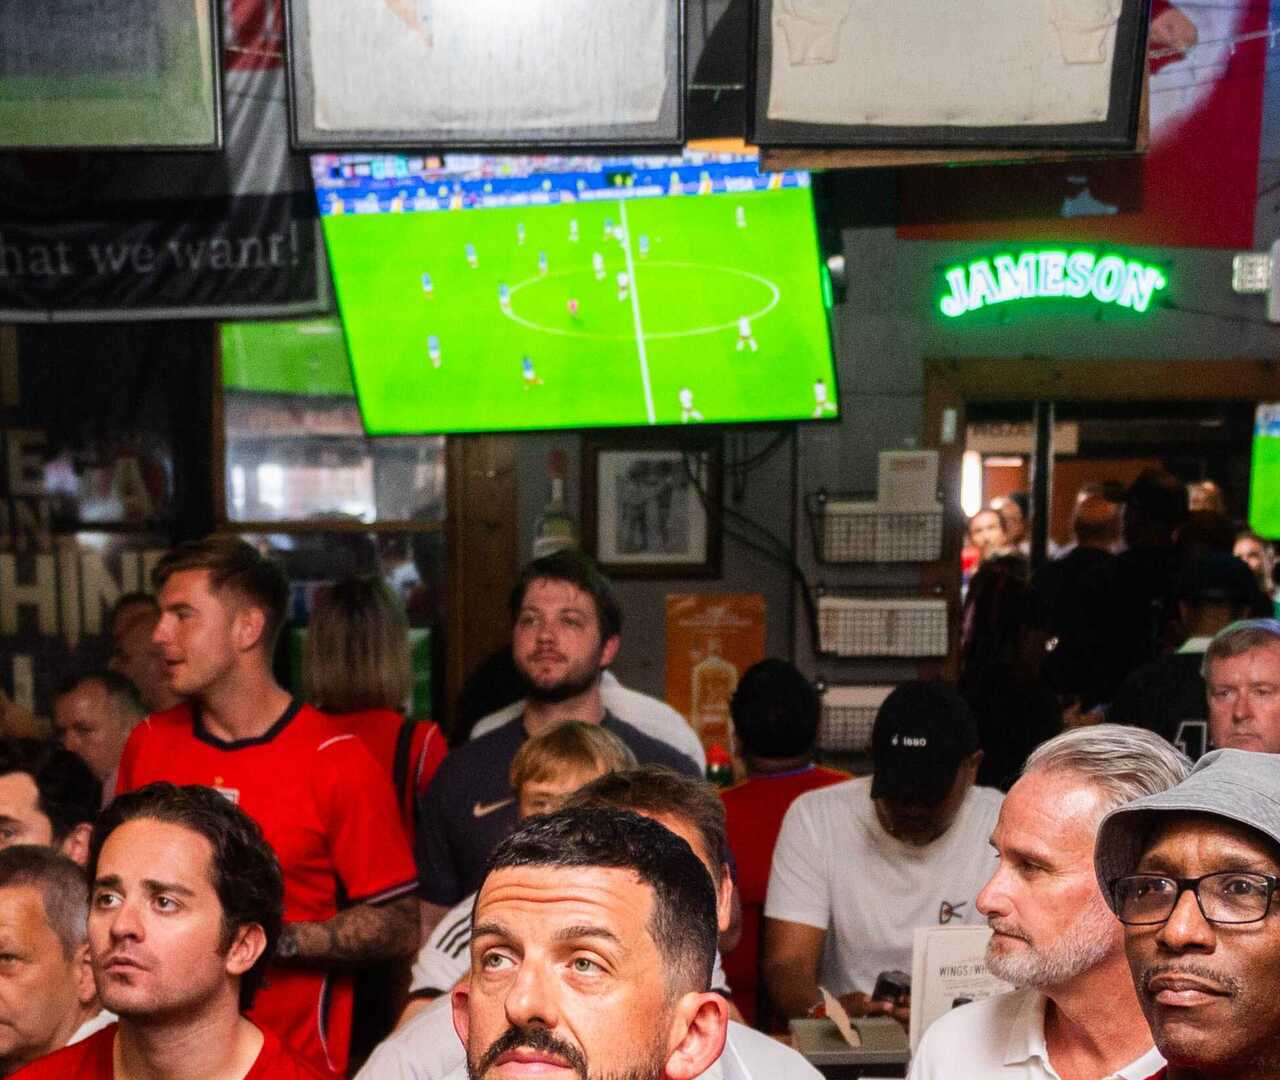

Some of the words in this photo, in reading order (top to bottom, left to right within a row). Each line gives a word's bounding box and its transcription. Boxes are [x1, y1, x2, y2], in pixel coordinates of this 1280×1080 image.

[90, 240, 157, 275] we
[166, 223, 300, 271] want!
[940, 252, 1160, 317] JAMESON
[939, 966, 967, 977] WINGS
